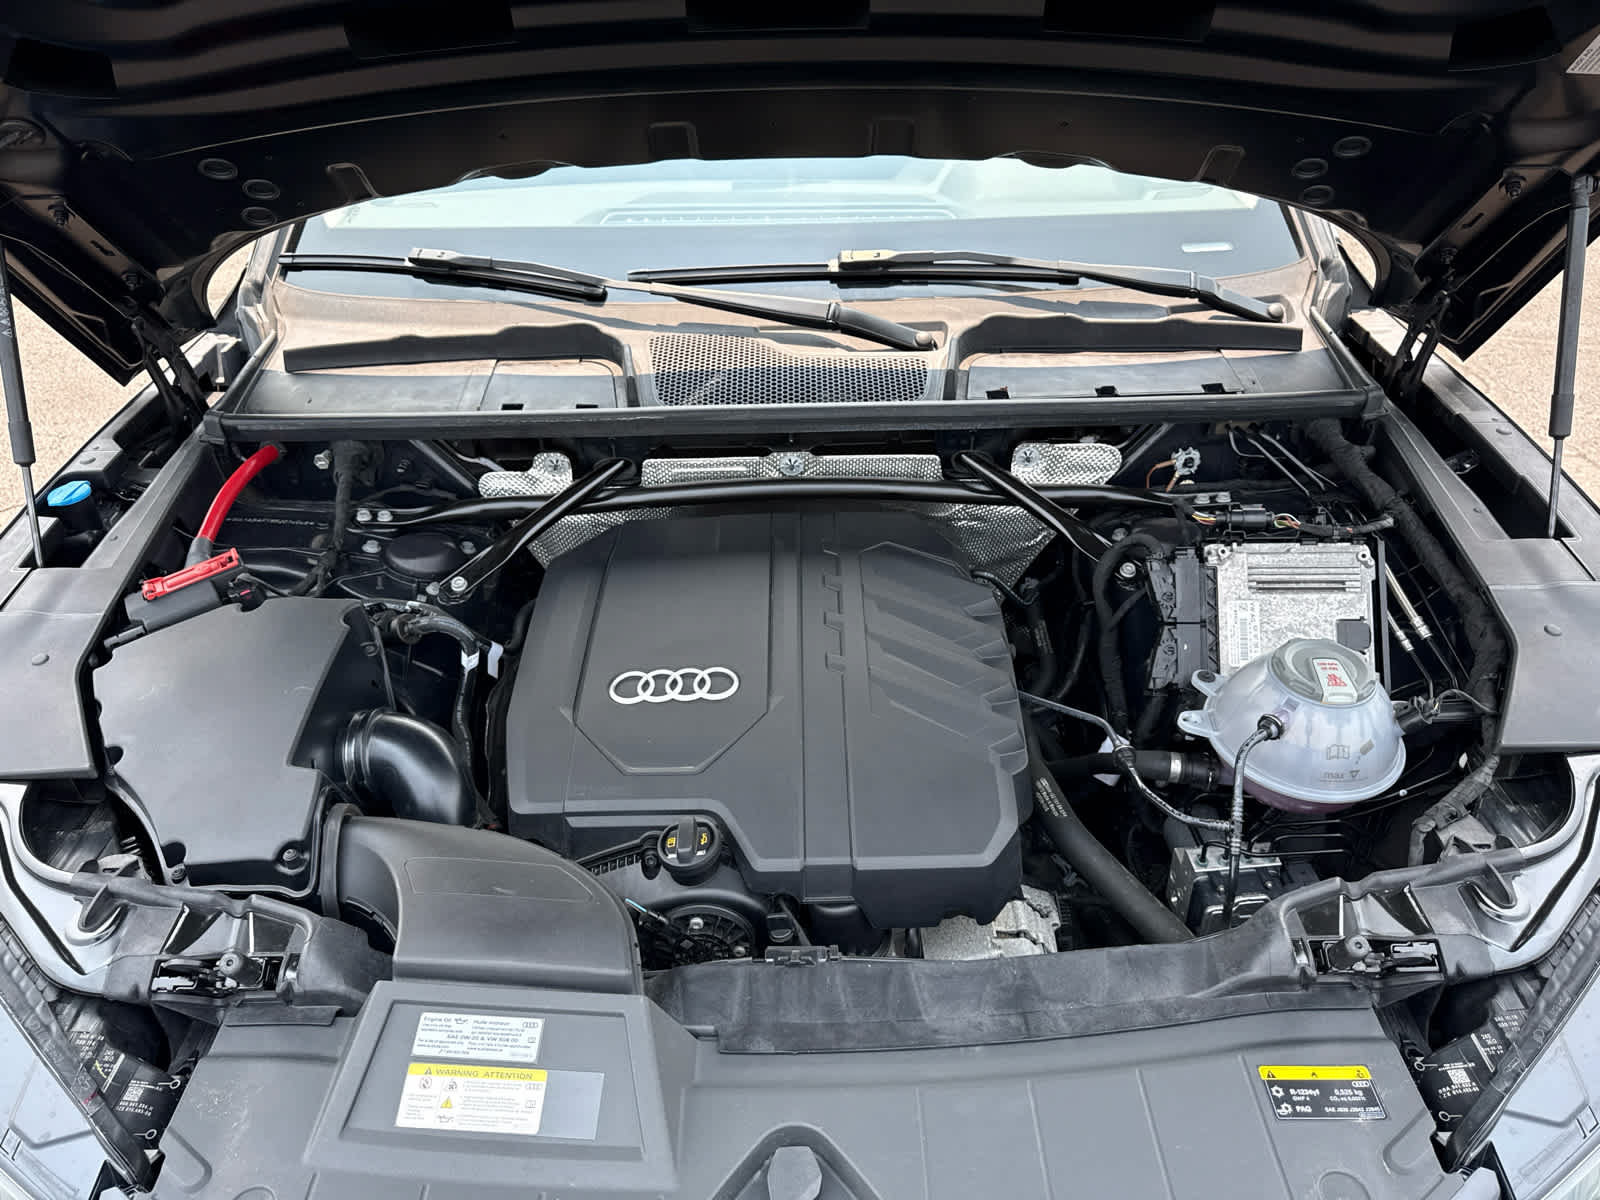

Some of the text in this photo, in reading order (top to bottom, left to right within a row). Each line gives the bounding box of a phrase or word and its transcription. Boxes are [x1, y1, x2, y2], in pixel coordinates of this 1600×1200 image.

[423, 1015, 442, 1023] Engine
[435, 1068, 534, 1080] WARNING ATTENTION
